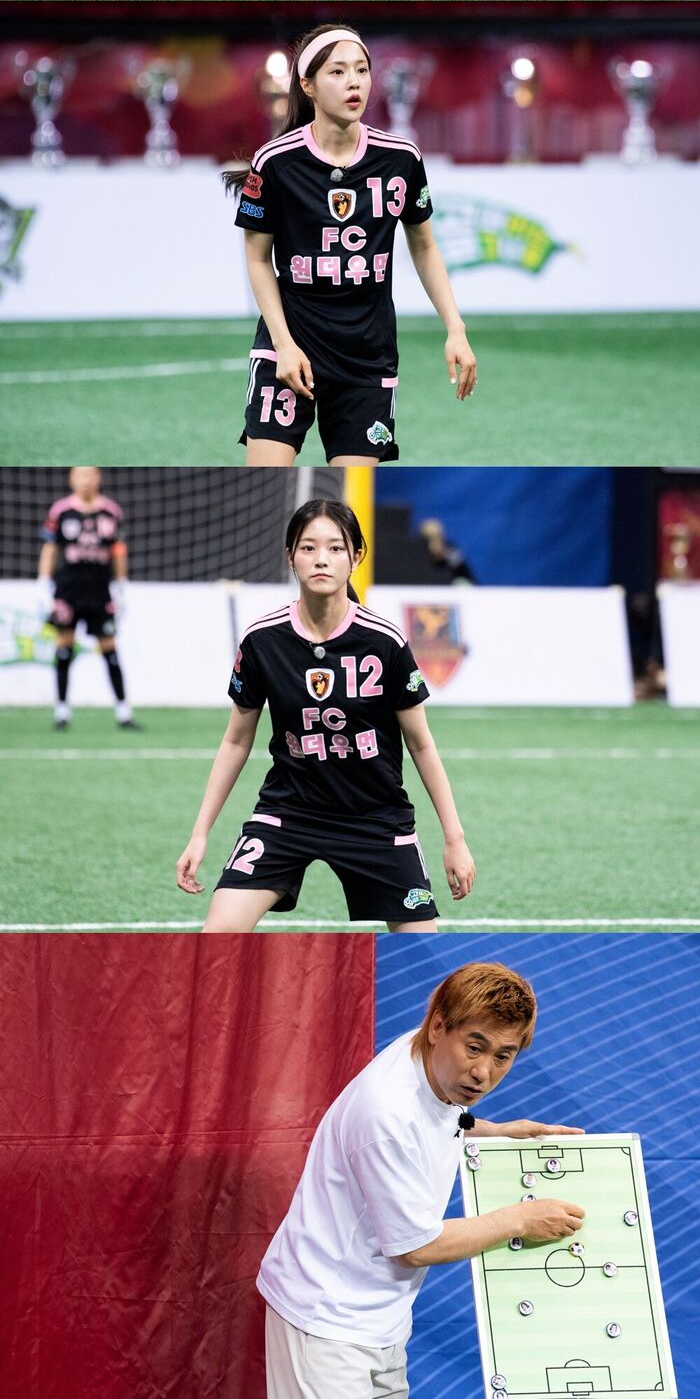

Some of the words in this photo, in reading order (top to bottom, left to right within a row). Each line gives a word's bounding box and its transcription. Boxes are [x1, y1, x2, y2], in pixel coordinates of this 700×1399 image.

[240, 201, 265, 219] SBS
[366, 176, 407, 218] 13
[322, 225, 367, 252] FC
[290, 252, 389, 285] 원더우먼
[259, 386, 297, 427] 13
[340, 654, 384, 698] 12
[302, 707, 347, 731] FC
[285, 728, 379, 762] 원더우먼
[225, 835, 265, 875] 12
